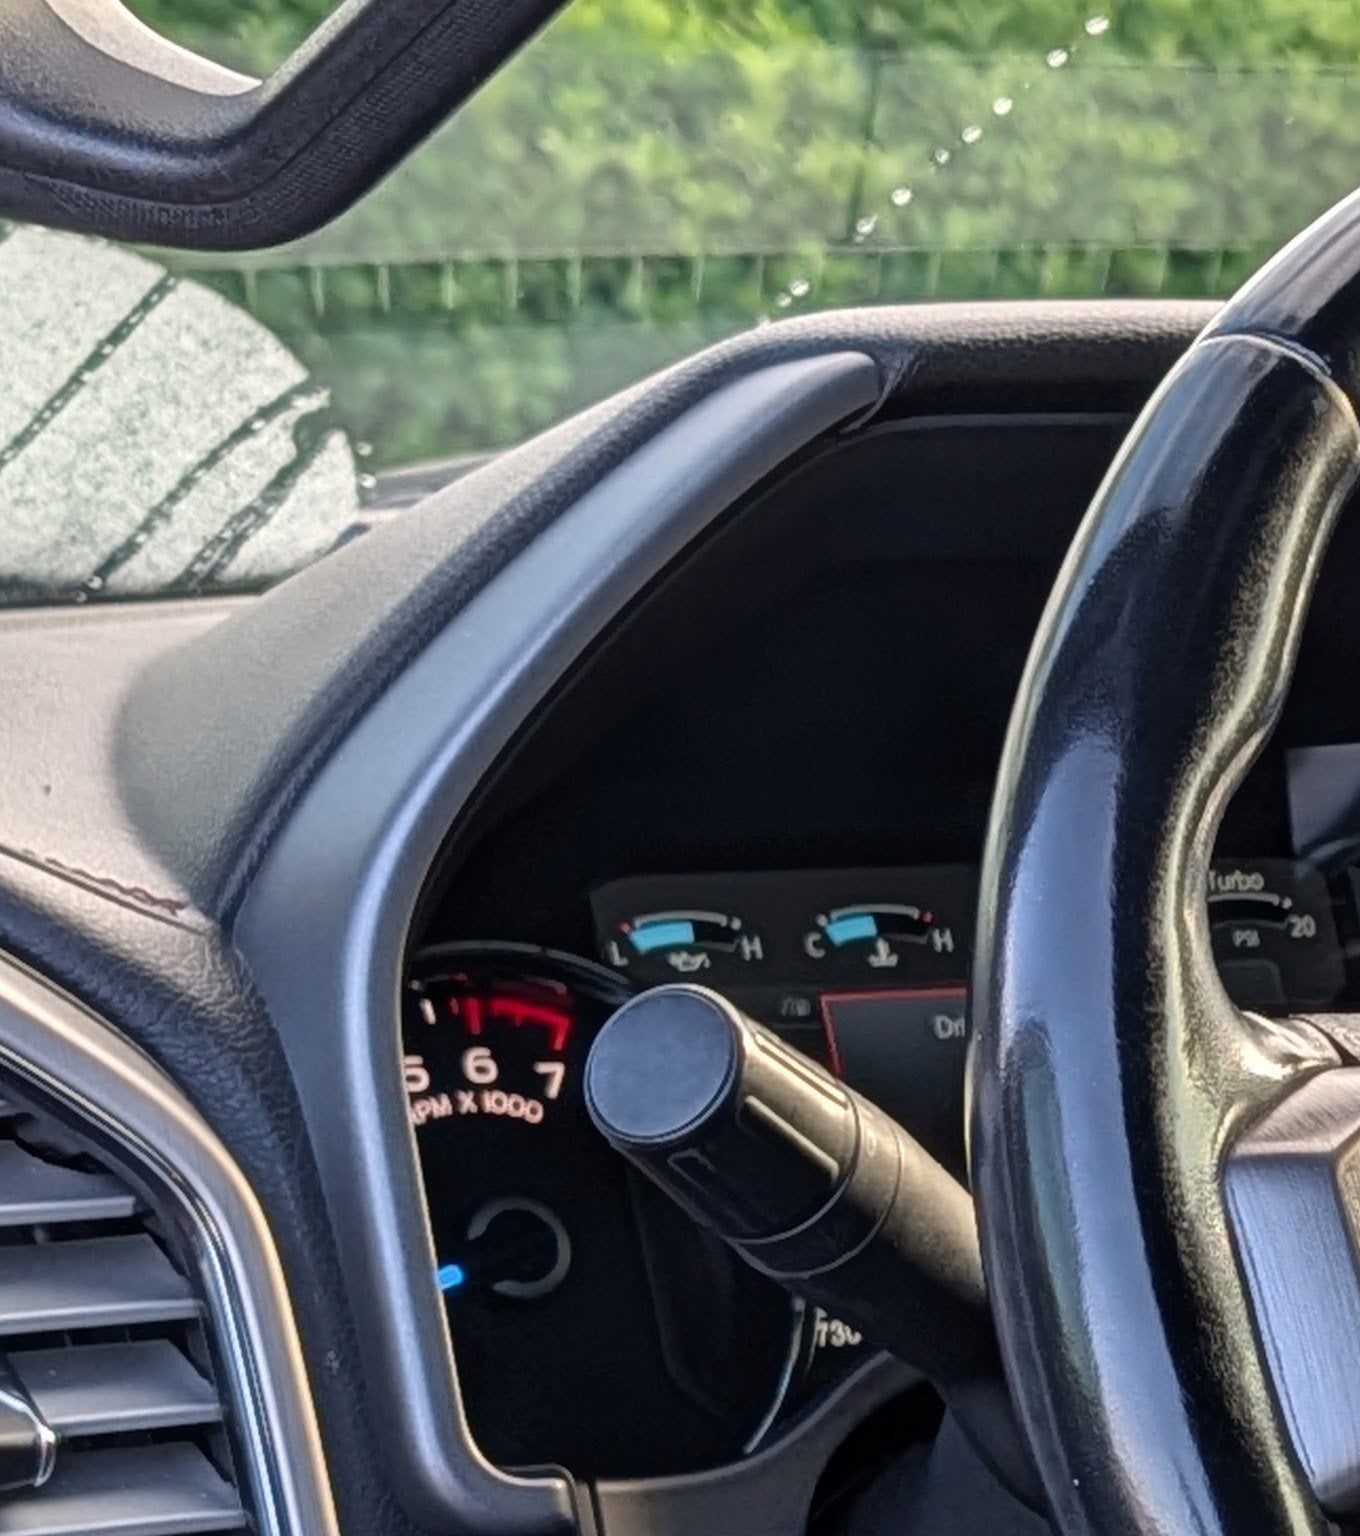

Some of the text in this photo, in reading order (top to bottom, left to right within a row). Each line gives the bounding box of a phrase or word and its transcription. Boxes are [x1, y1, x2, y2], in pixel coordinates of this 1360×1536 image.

[932, 928, 954, 953] H
[1286, 915, 1316, 939] 20
[740, 935, 763, 961] H
[804, 932, 826, 958] C
[402, 1055, 431, 1093] 5
[462, 1046, 499, 1085] 6
[533, 1061, 566, 1099] 7
[456, 1090, 478, 1114] X
[480, 1090, 544, 1124] 1000
